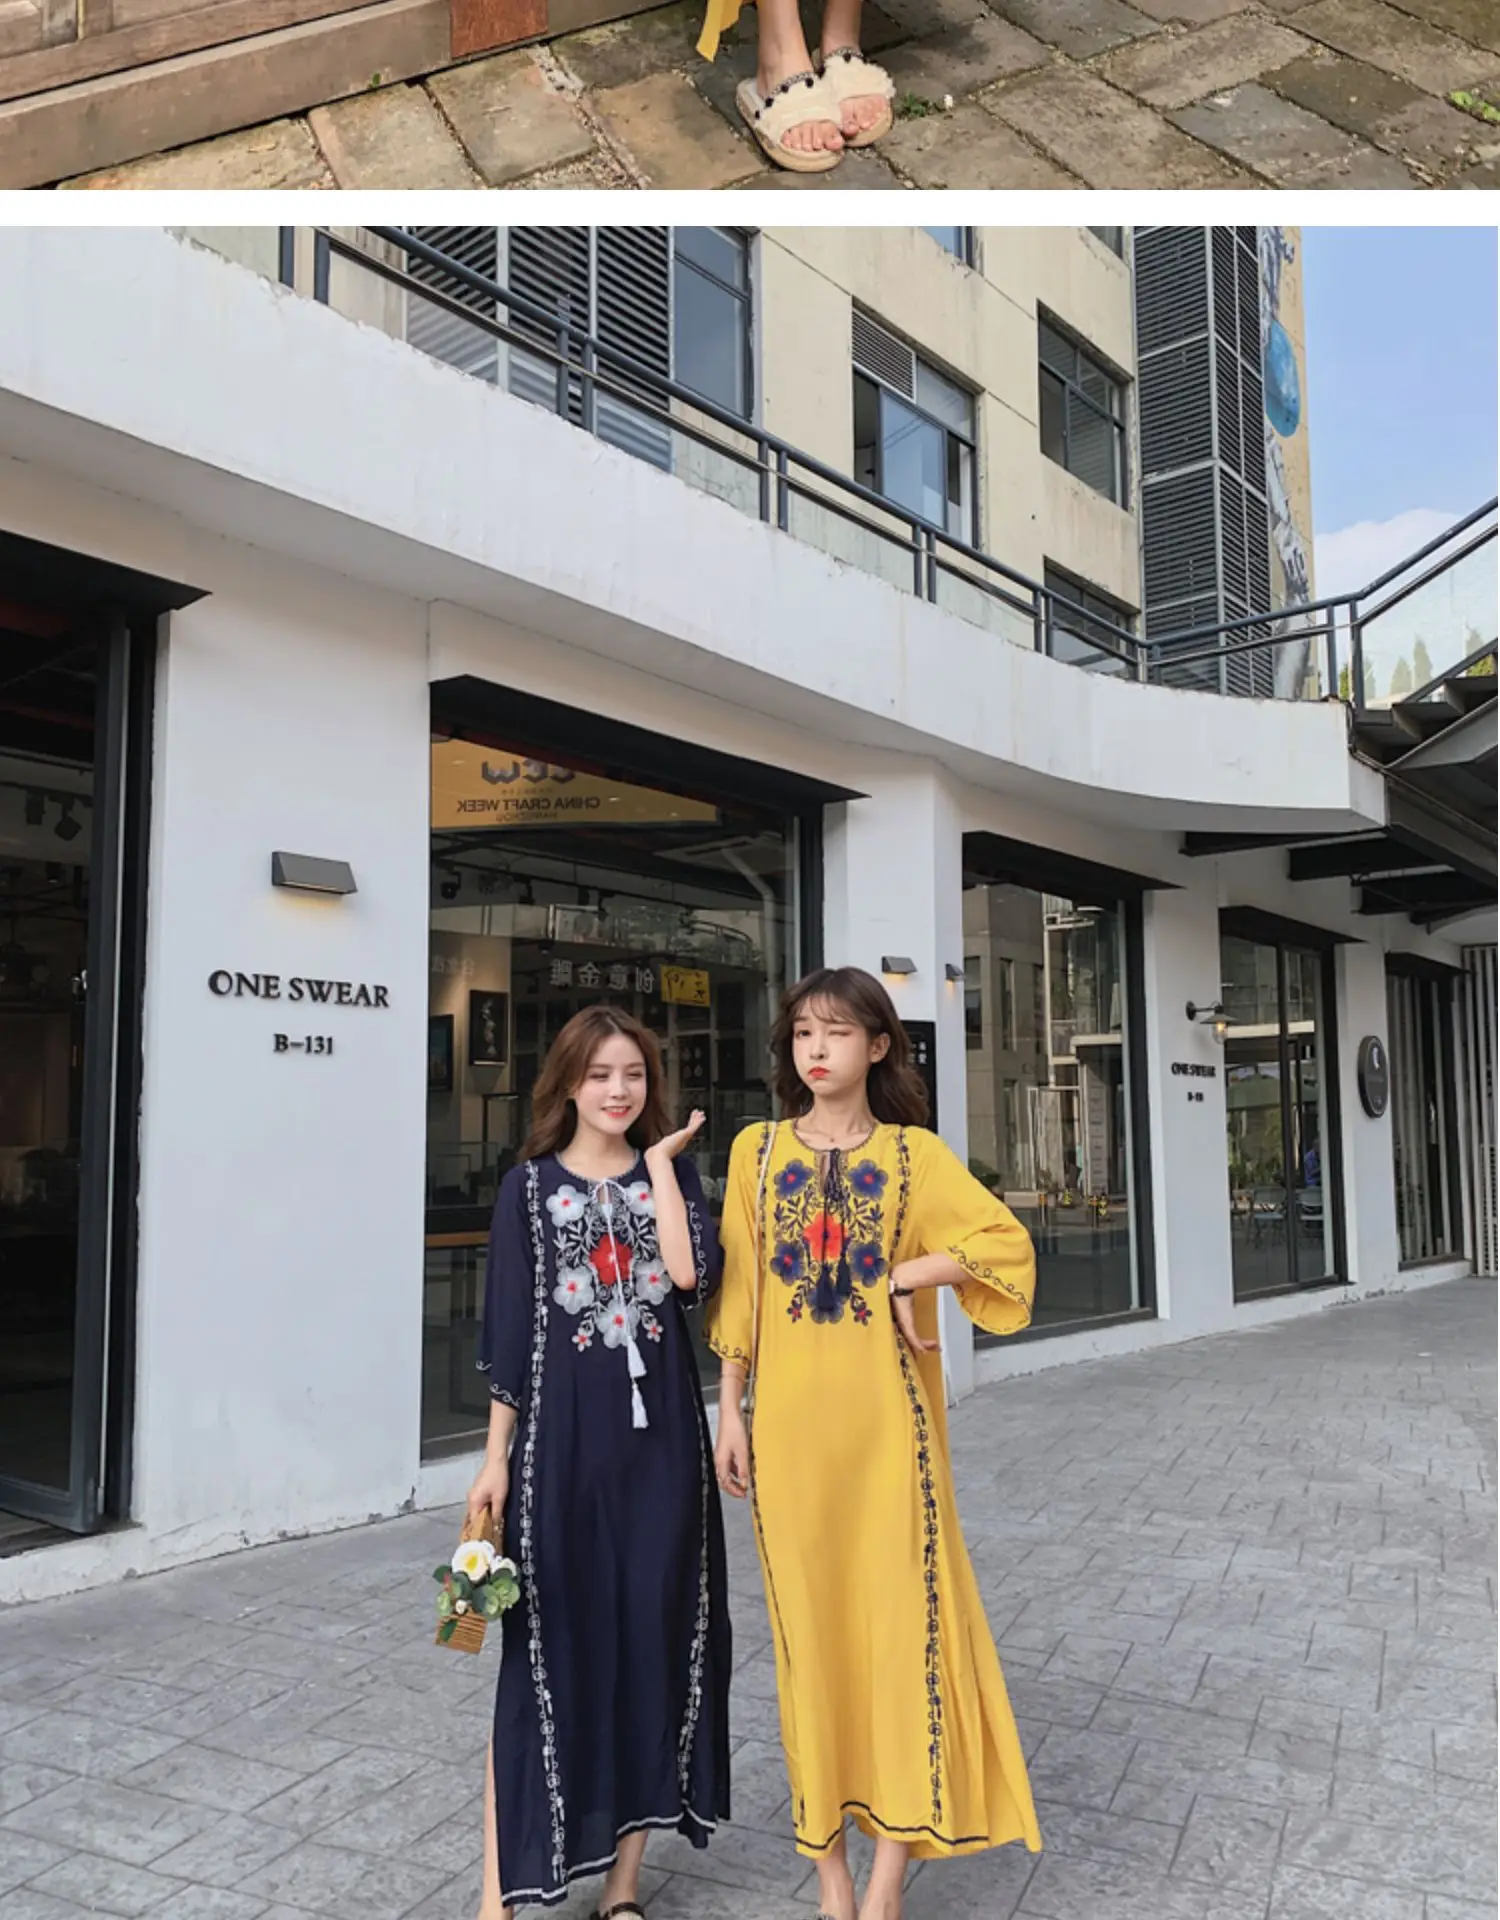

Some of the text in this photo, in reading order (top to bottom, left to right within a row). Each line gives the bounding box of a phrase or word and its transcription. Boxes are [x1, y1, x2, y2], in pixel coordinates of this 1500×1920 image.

[207, 969, 390, 1008] ONE SWEAR
[272, 1033, 334, 1055] B-131
